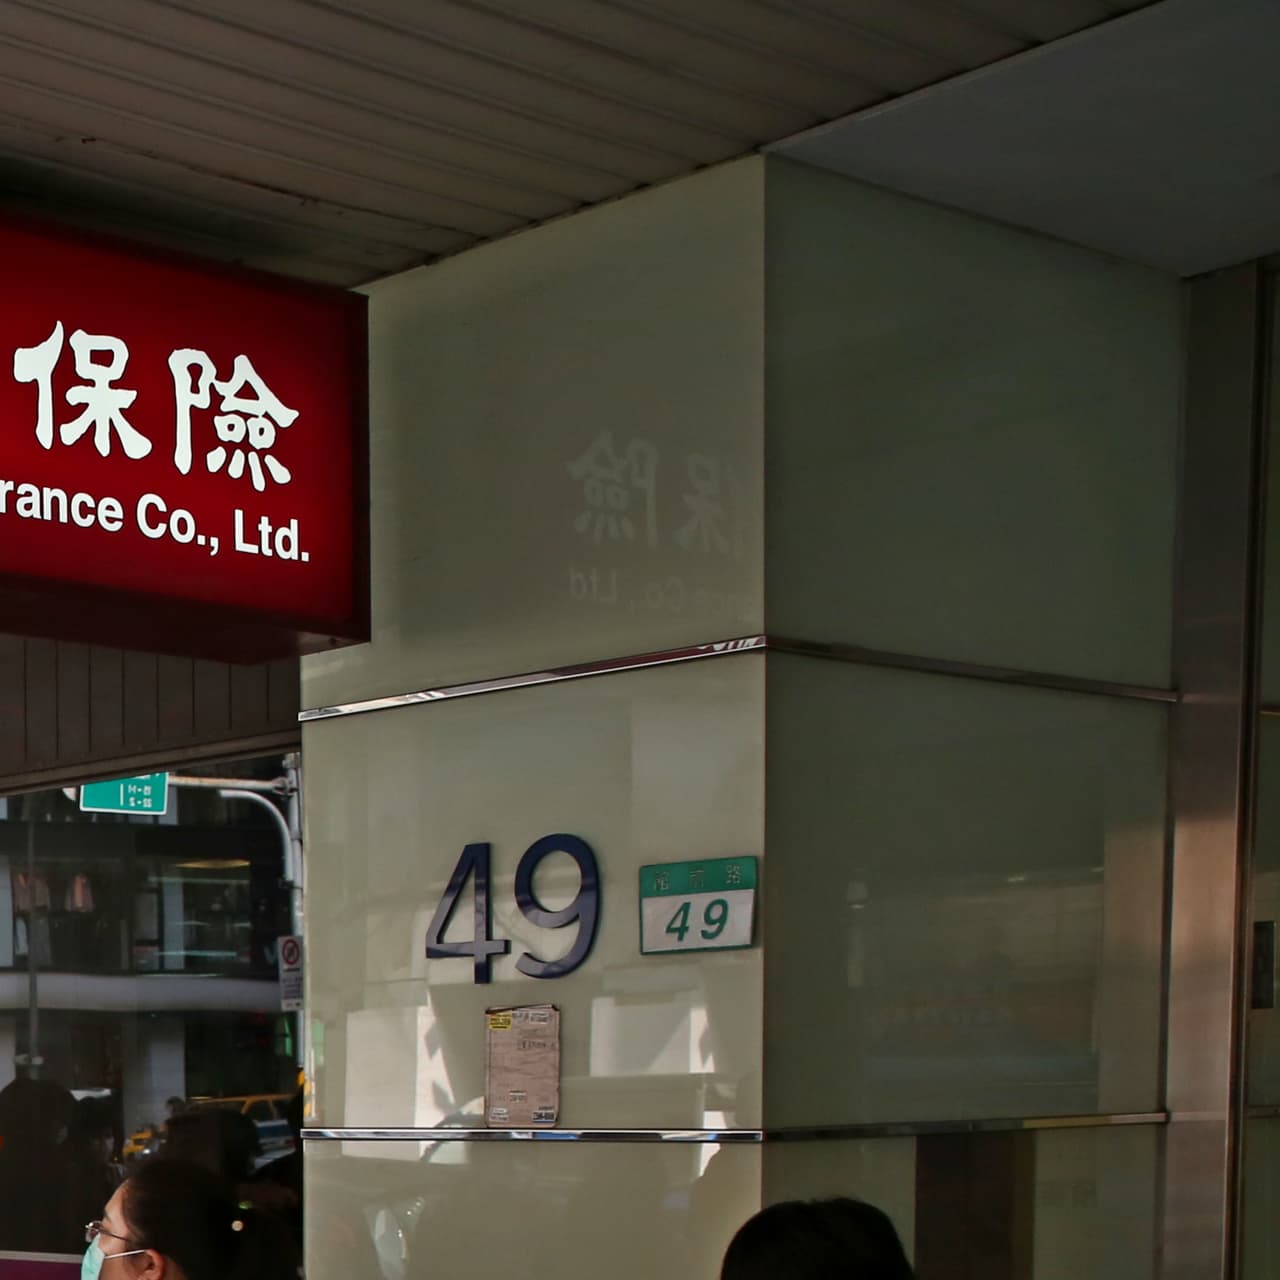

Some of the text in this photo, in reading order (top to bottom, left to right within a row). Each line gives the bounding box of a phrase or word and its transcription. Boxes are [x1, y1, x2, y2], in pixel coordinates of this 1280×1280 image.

[136, 492, 219, 556] Co.,
[233, 508, 311, 562] Ltd.
[424, 832, 602, 985] 49
[665, 898, 729, 942] 49
